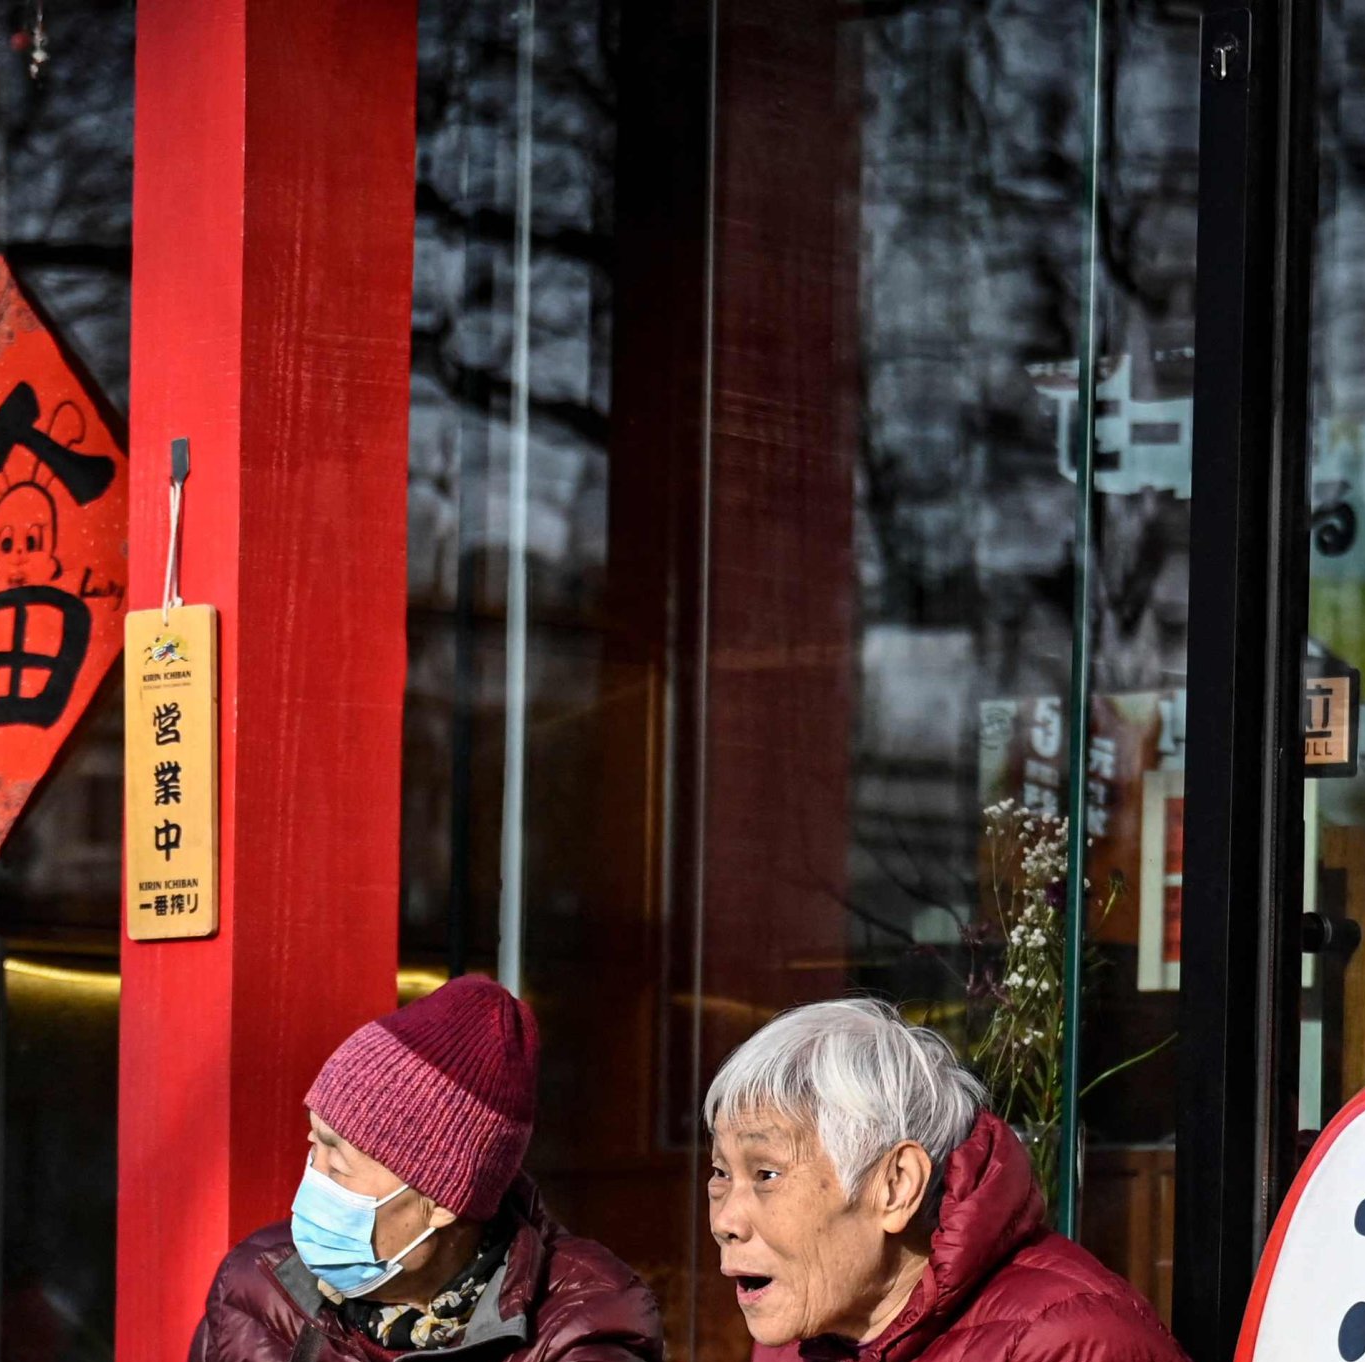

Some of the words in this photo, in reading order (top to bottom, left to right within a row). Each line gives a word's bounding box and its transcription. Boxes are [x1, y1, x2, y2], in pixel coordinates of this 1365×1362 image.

[142, 673, 162, 682] KIRIN
[163, 670, 192, 680] ICHIBAN
[152, 702, 182, 862] 営業中
[138, 881, 162, 891] KIRIN
[164, 878, 199, 889] ICHIBAN
